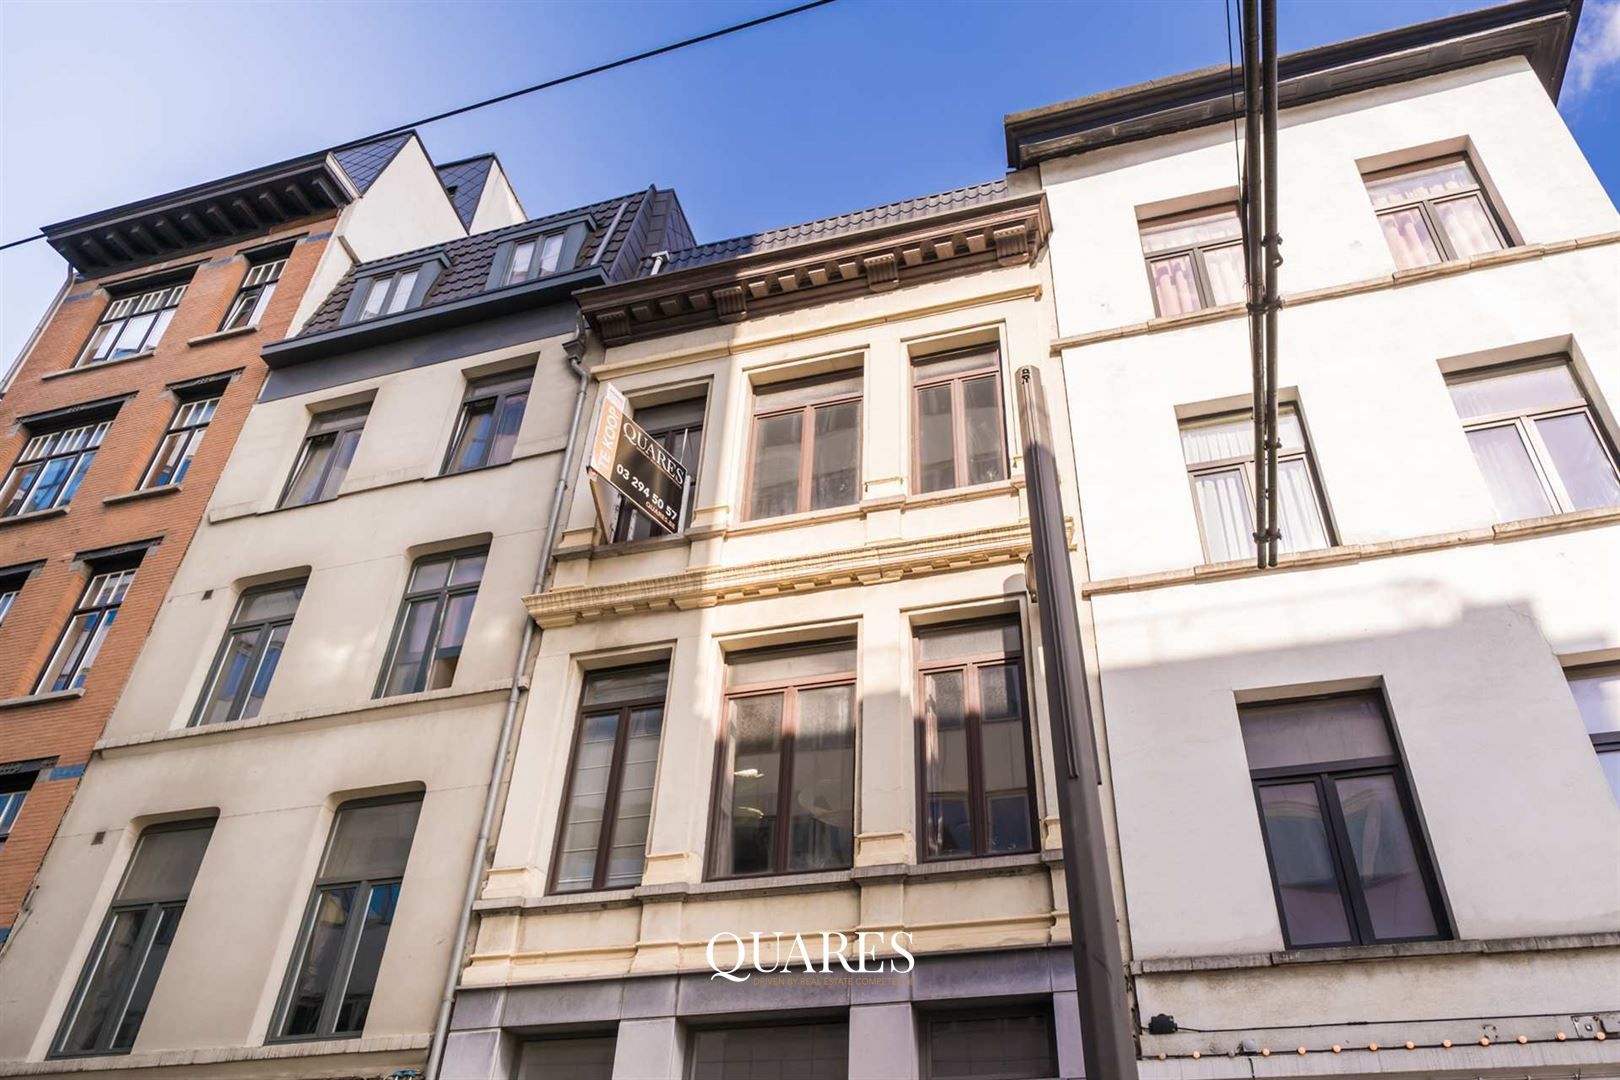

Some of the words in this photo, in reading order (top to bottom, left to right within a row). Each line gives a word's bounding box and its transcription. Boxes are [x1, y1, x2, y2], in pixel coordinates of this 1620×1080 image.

[602, 408, 620, 451] KOOP
[623, 421, 685, 485] QUARES
[599, 450, 610, 470] TE
[616, 463, 629, 480] 03
[631, 476, 650, 497] 294
[652, 493, 664, 509] 50
[665, 505, 678, 520] 57
